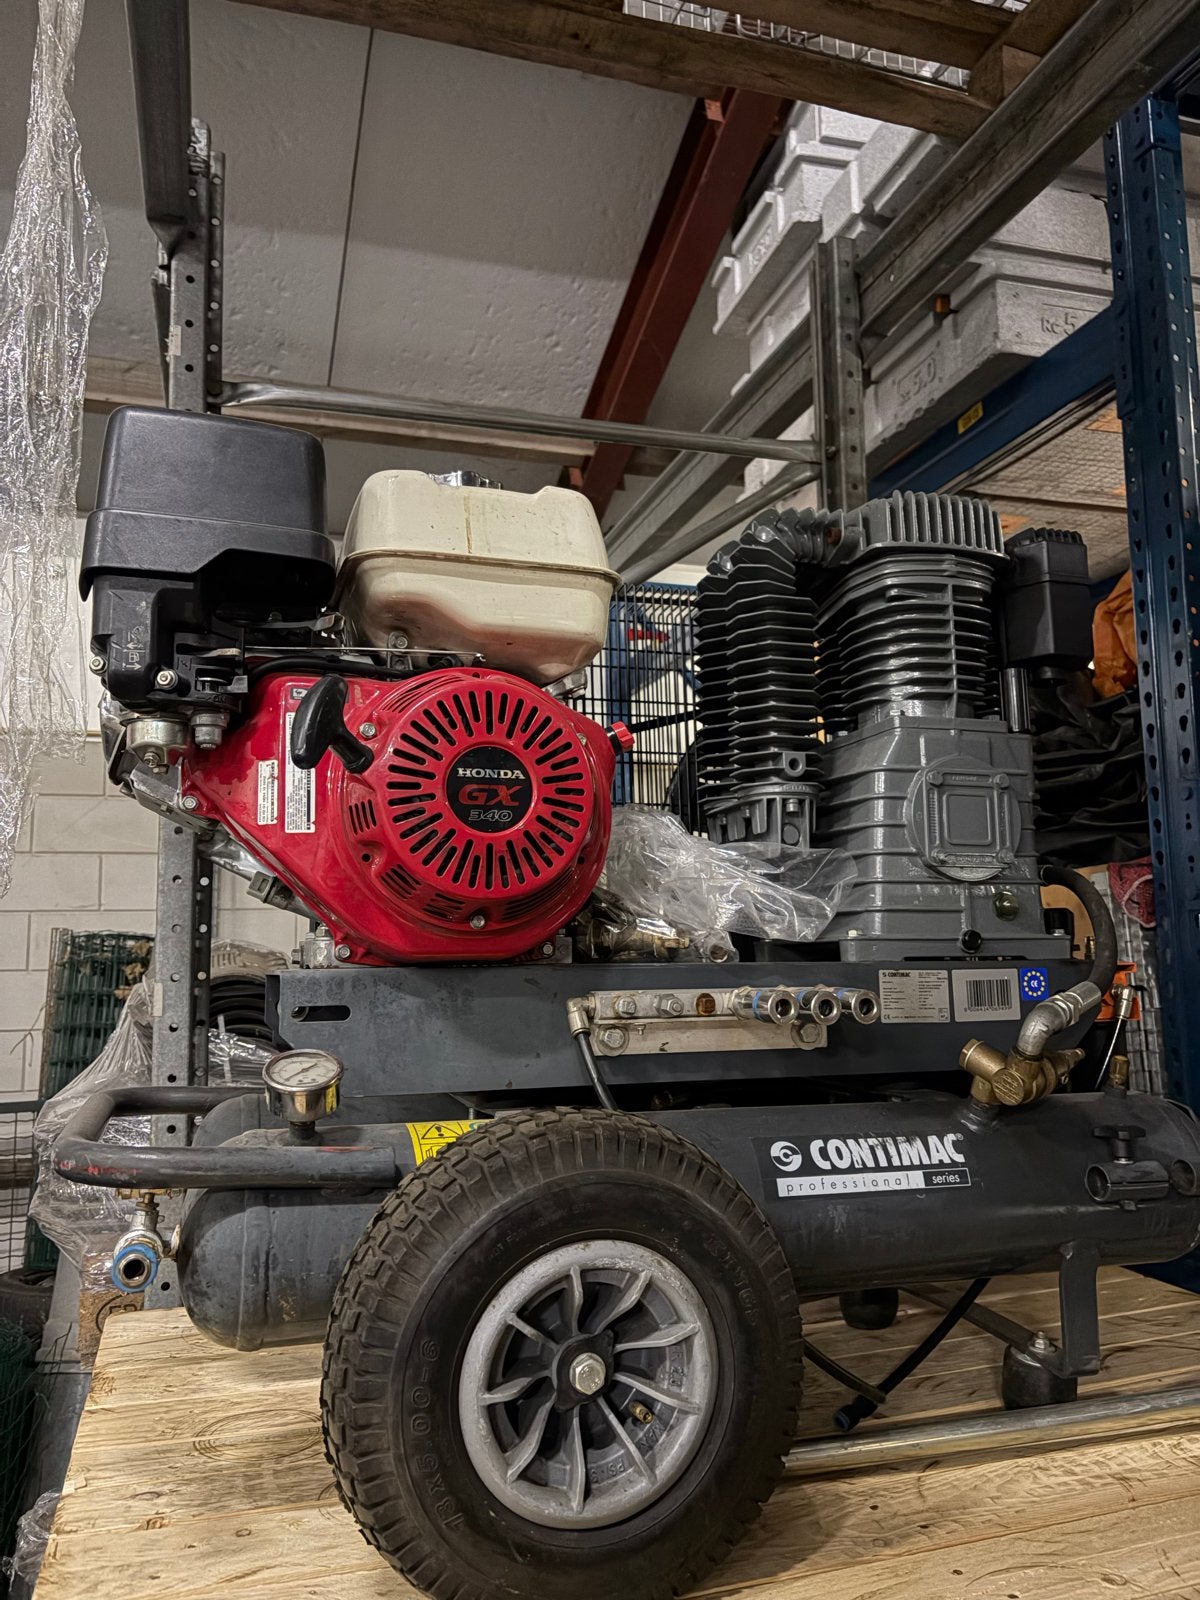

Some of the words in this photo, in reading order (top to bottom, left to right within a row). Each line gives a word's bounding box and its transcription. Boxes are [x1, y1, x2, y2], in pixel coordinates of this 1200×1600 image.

[457, 767, 526, 779] HONDA
[458, 784, 523, 806] GX
[468, 809, 513, 822] 340
[786, 1173, 910, 1196] professional
[932, 1173, 961, 1185] series
